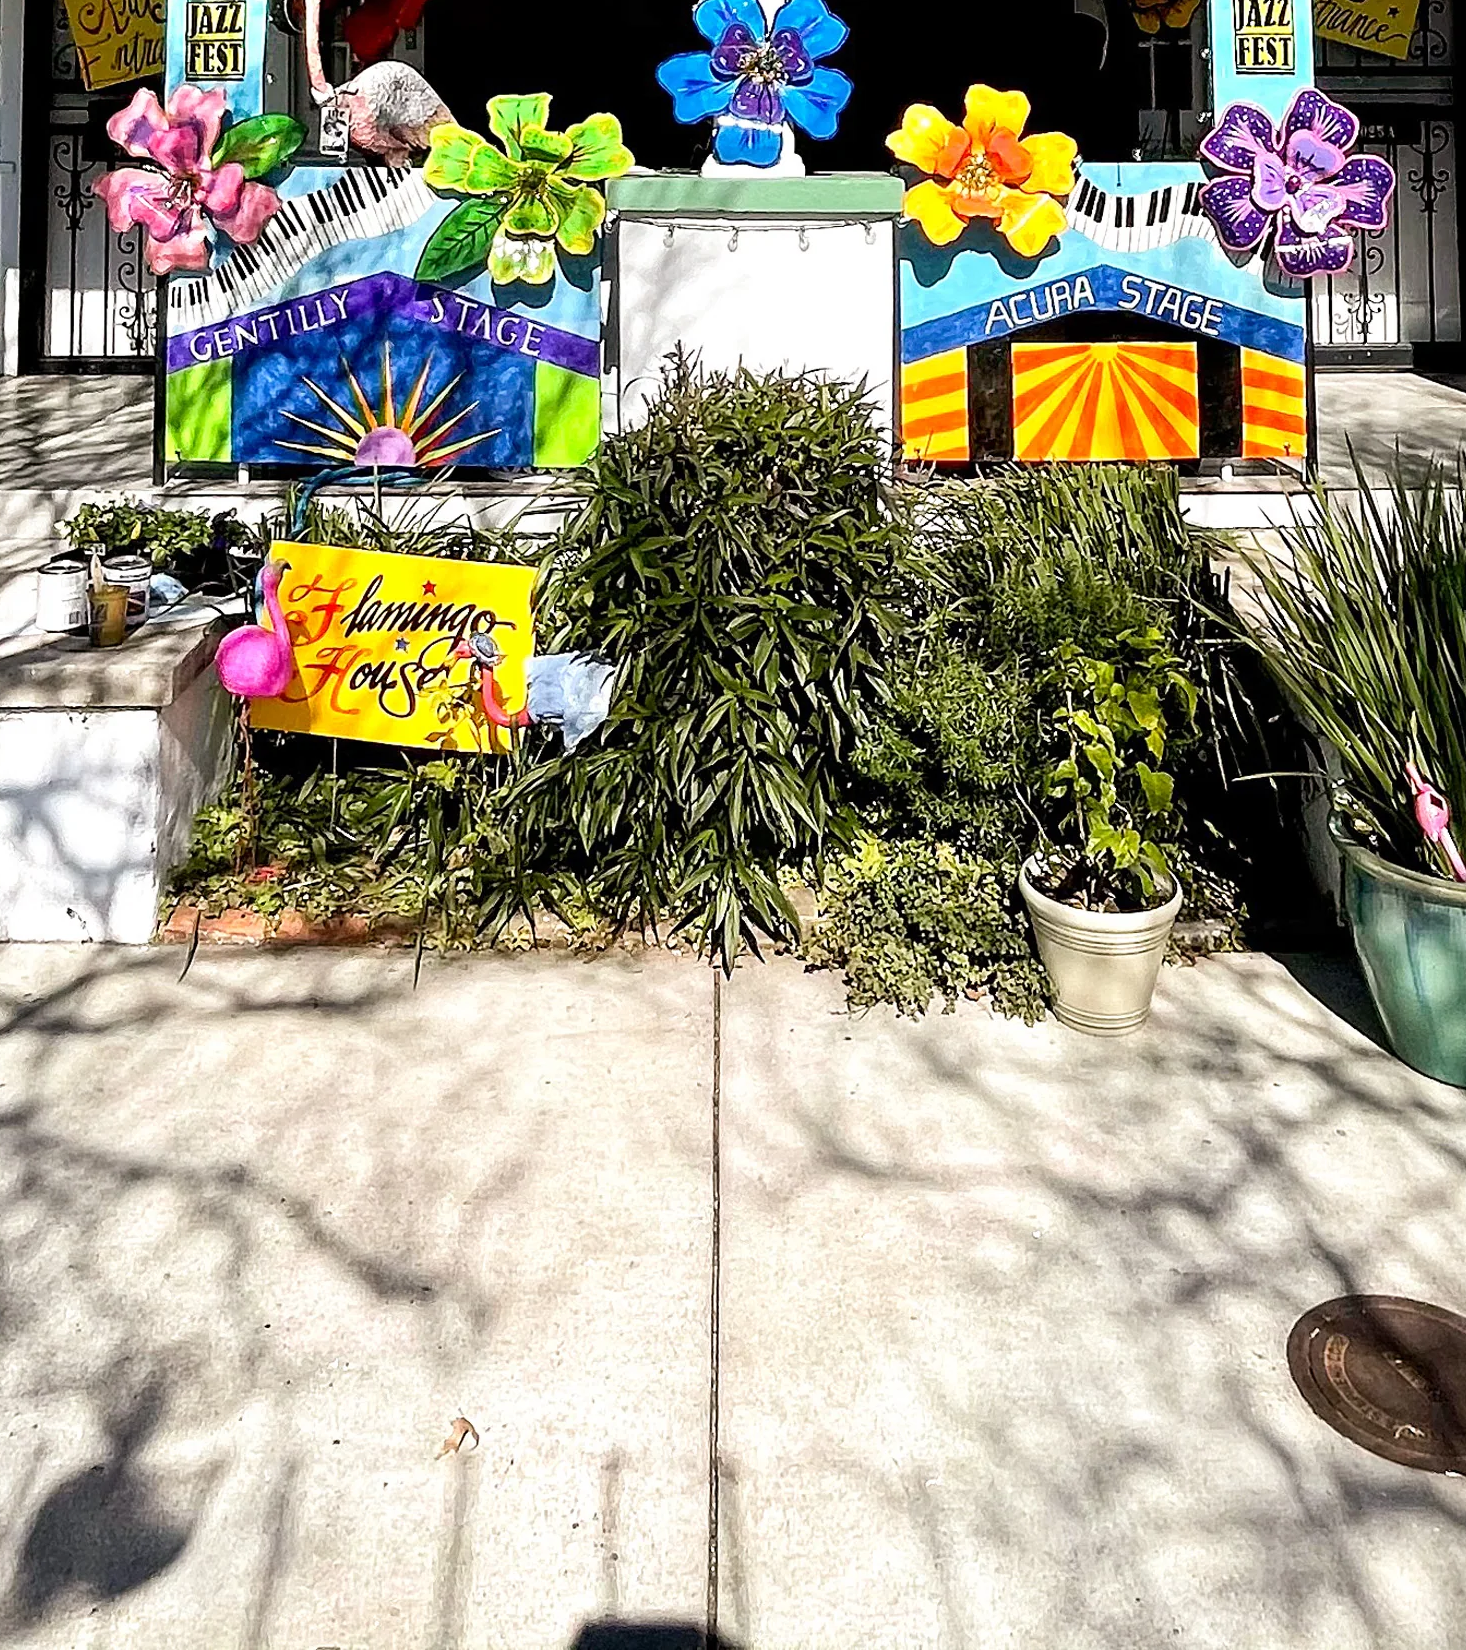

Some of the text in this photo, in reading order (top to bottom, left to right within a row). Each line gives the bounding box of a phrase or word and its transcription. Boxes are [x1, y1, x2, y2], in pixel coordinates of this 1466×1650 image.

[188, 3, 243, 39] JAZZ
[76, 31, 166, 89] Entra
[188, 41, 244, 74] FEST
[1236, 36, 1292, 67] FEST
[188, 287, 548, 362] GENTILLY STAGE
[984, 275, 1225, 337] ACURA STAGE
[284, 574, 517, 669] Flamingo
[281, 644, 453, 718] House
